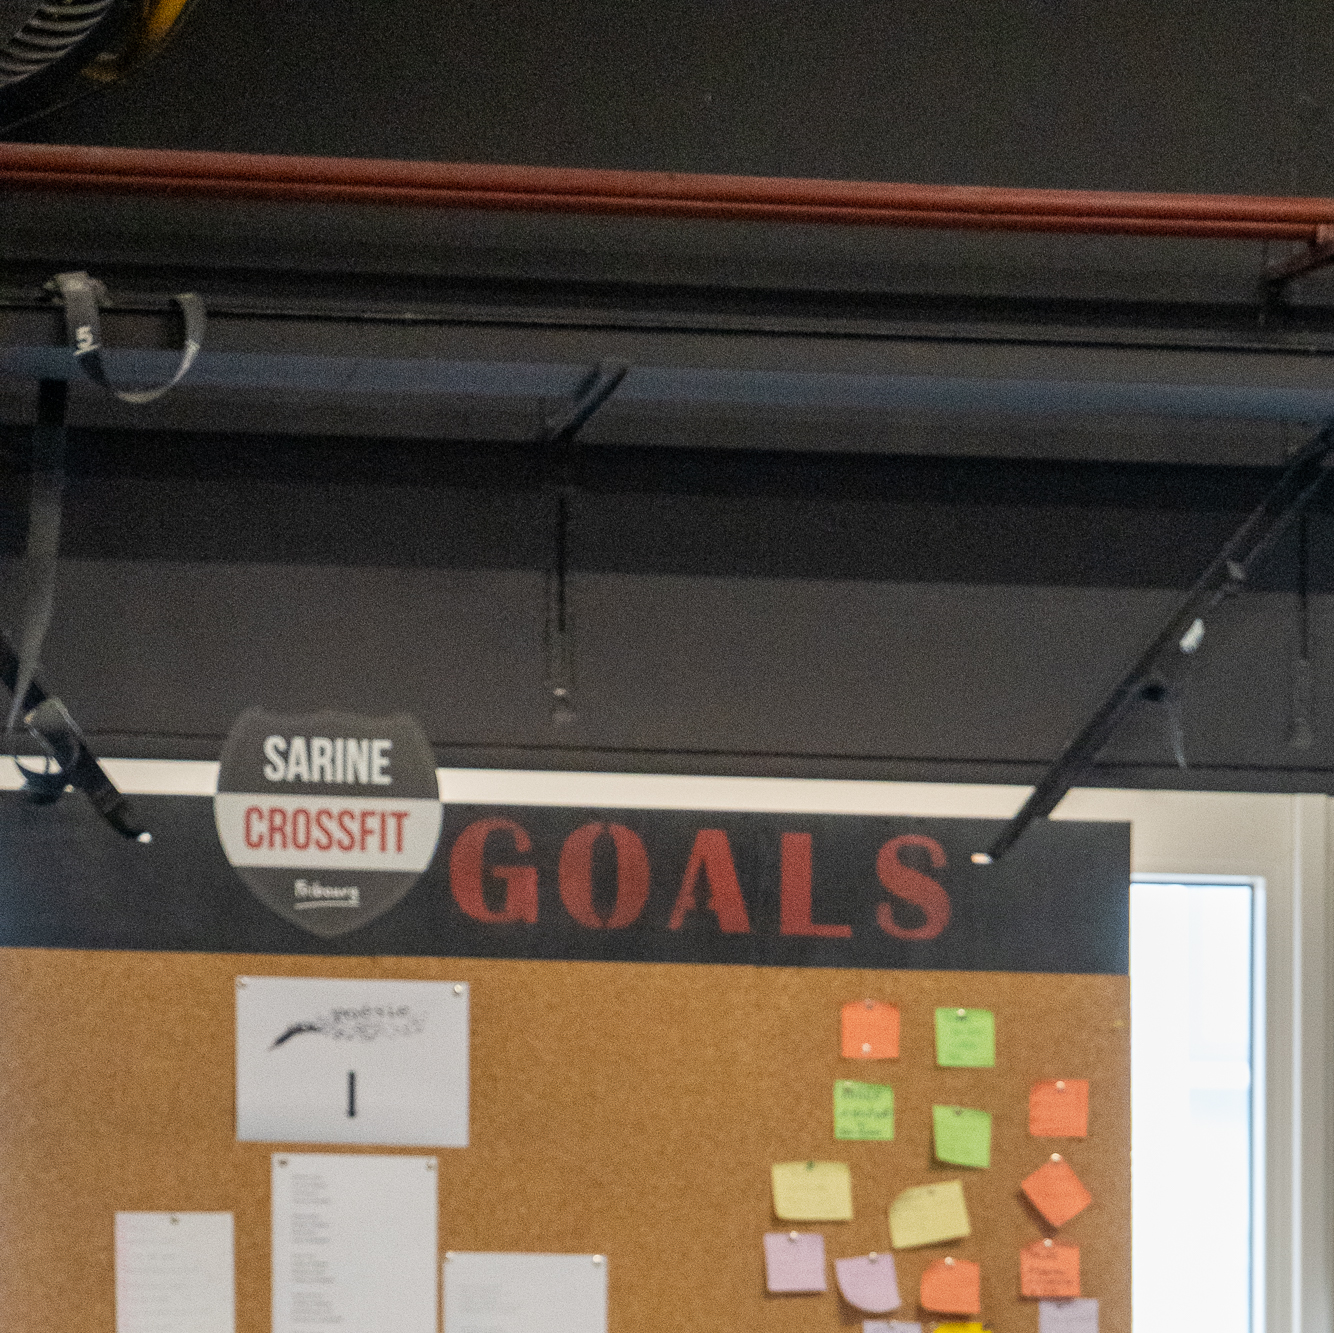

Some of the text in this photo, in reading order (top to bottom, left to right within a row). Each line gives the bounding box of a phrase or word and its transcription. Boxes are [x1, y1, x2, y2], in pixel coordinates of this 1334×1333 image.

[263, 735, 393, 786] SARINE
[244, 806, 409, 854] CROSSFIT
[449, 817, 951, 941] GOALS
